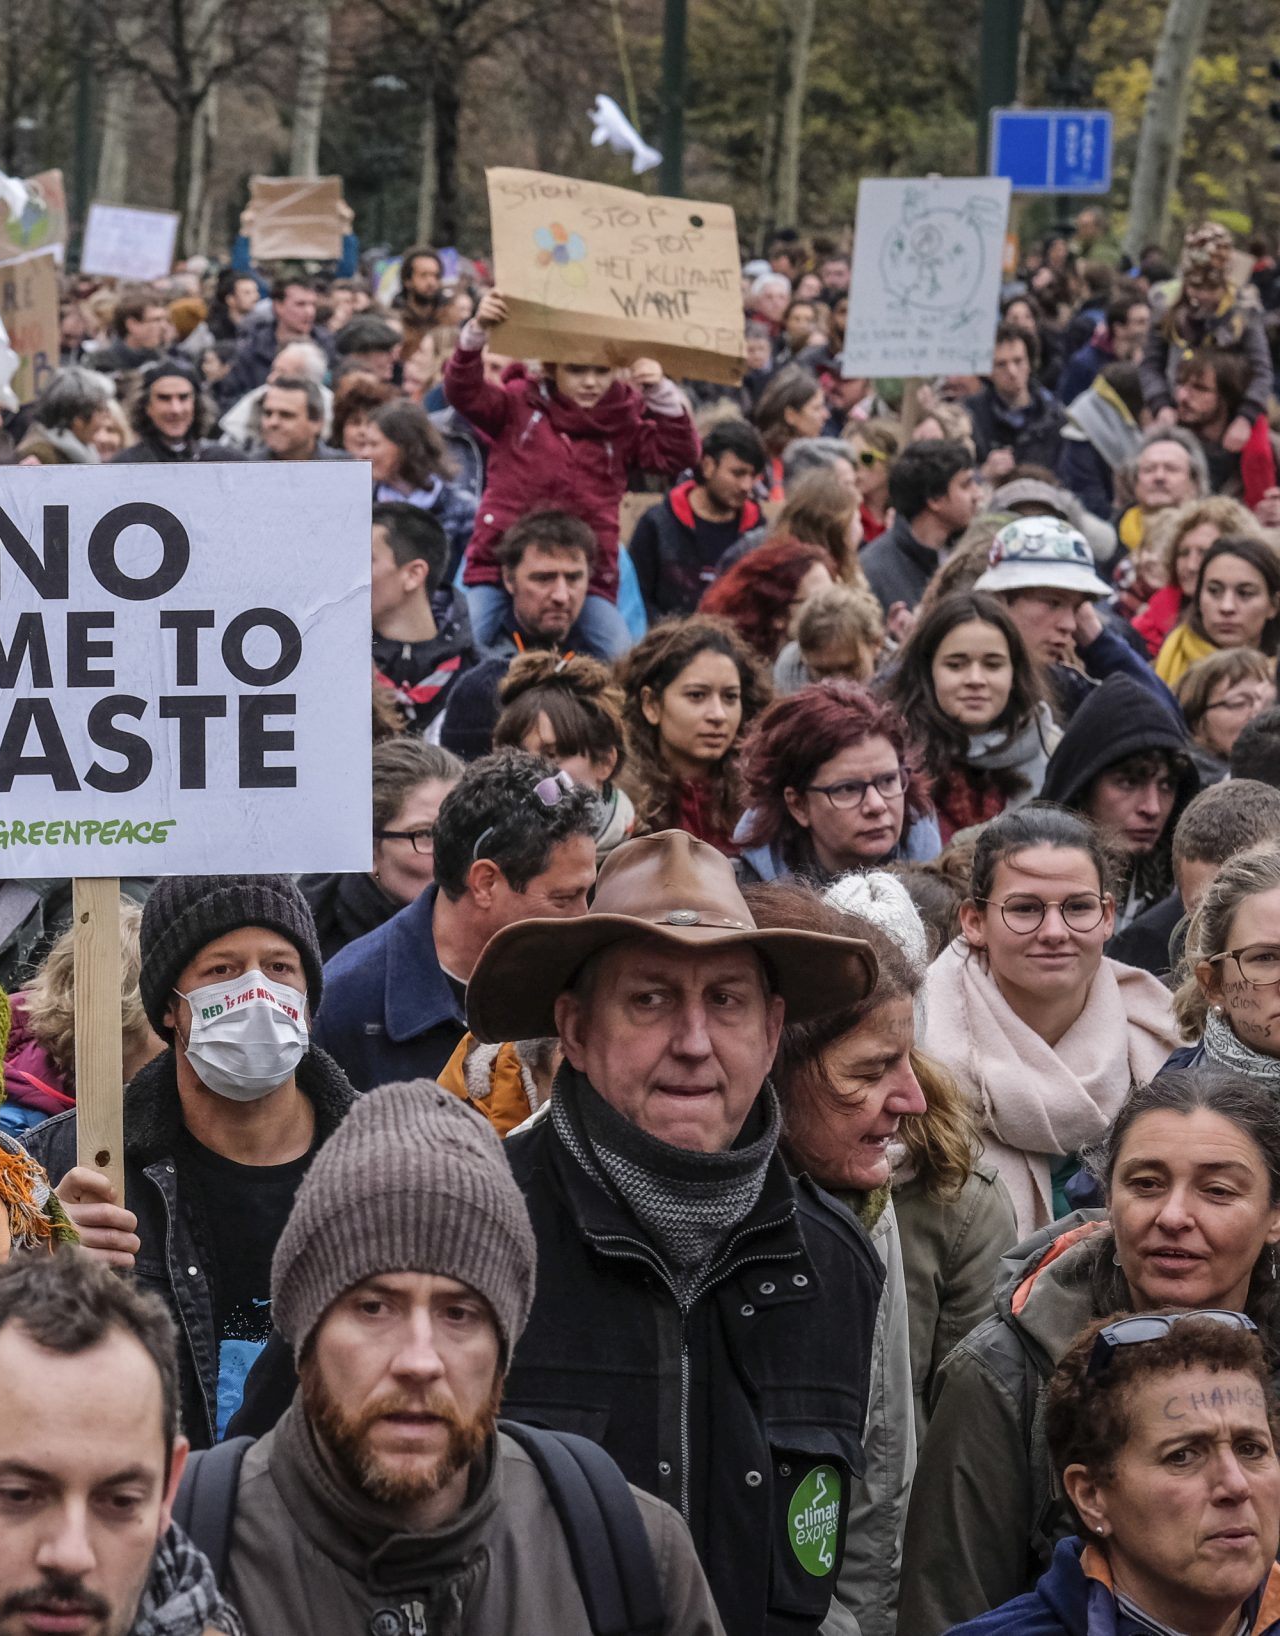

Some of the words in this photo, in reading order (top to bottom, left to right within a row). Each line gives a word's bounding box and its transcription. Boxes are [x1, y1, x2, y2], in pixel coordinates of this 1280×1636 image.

[581, 205, 668, 229] STOP
[631, 229, 704, 255] STOP
[596, 255, 632, 282] HET
[160, 607, 302, 687] TO
[201, 1004, 224, 1020] RED
[237, 989, 254, 1004] THE
[796, 1519, 839, 1545] expres
